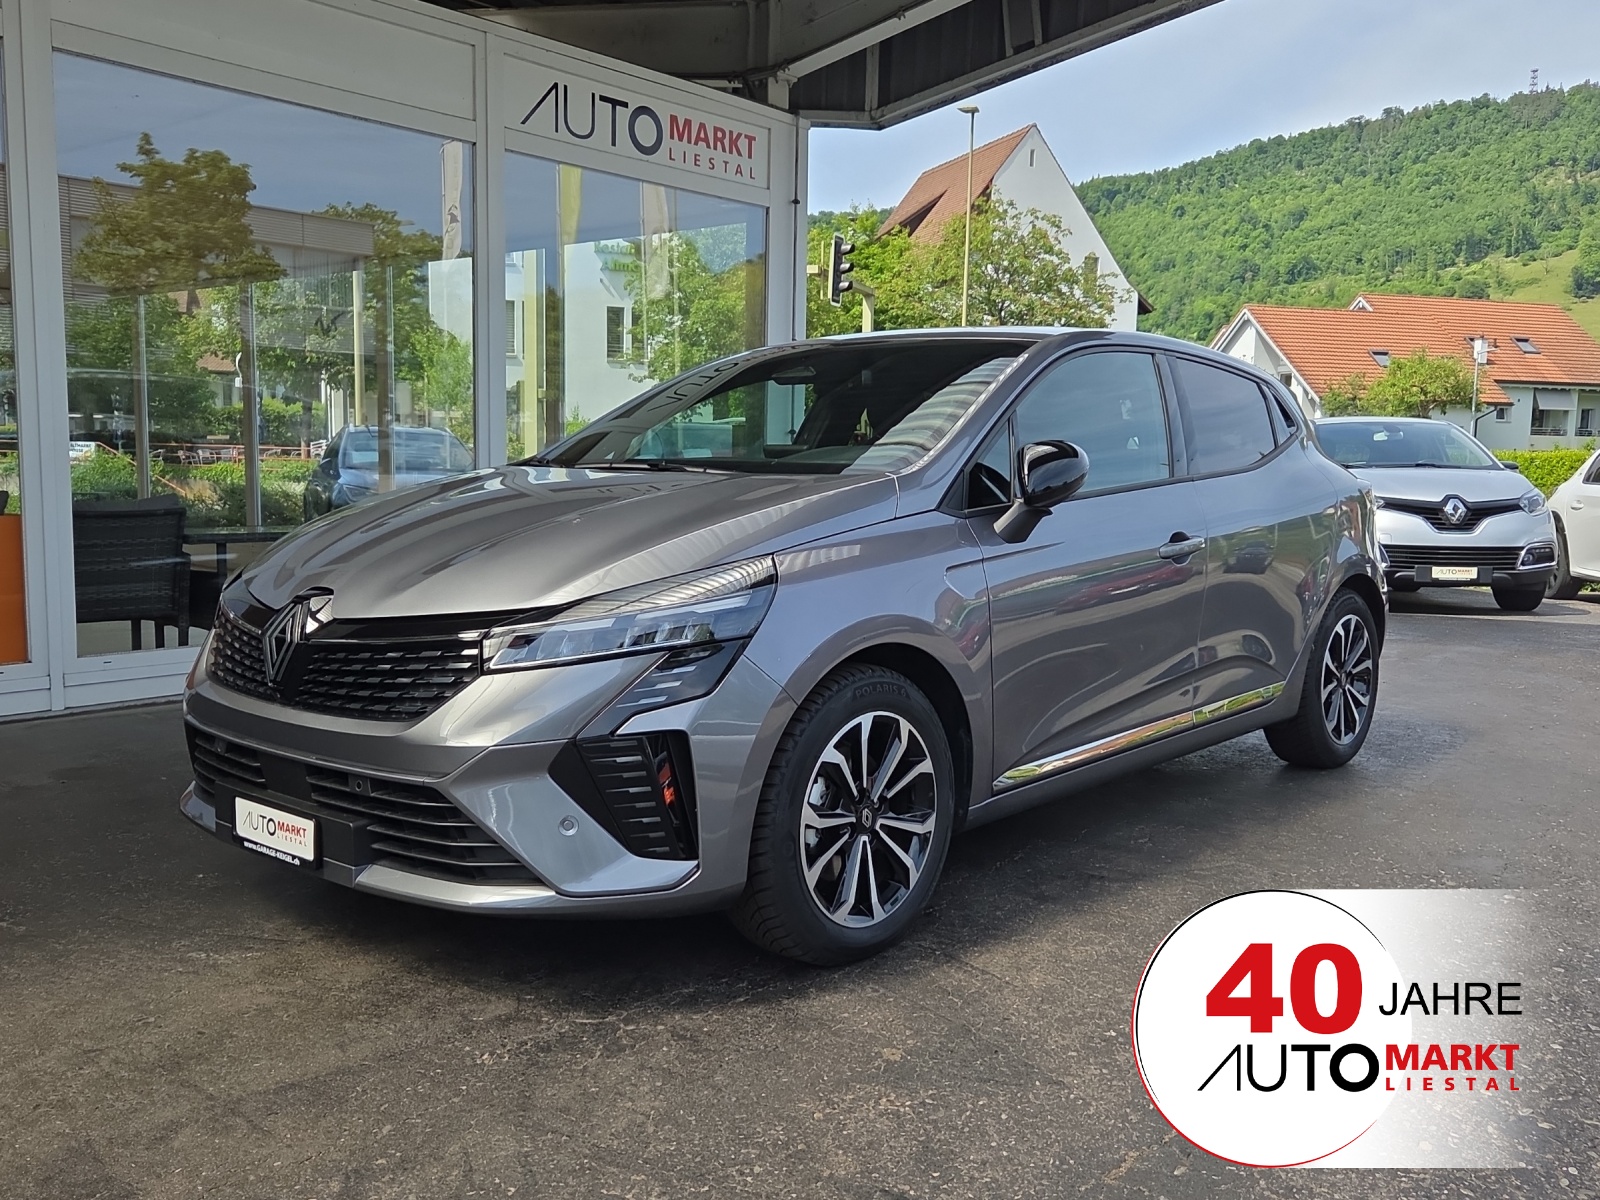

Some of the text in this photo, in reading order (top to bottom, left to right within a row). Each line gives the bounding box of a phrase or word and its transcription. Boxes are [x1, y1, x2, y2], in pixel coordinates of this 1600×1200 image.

[520, 81, 757, 160] AUTO MARKT
[668, 147, 756, 180] LIESTAL
[855, 684, 898, 698] POLARIS
[243, 810, 307, 838] AUTO MARKT
[276, 834, 307, 847] LIESTAL
